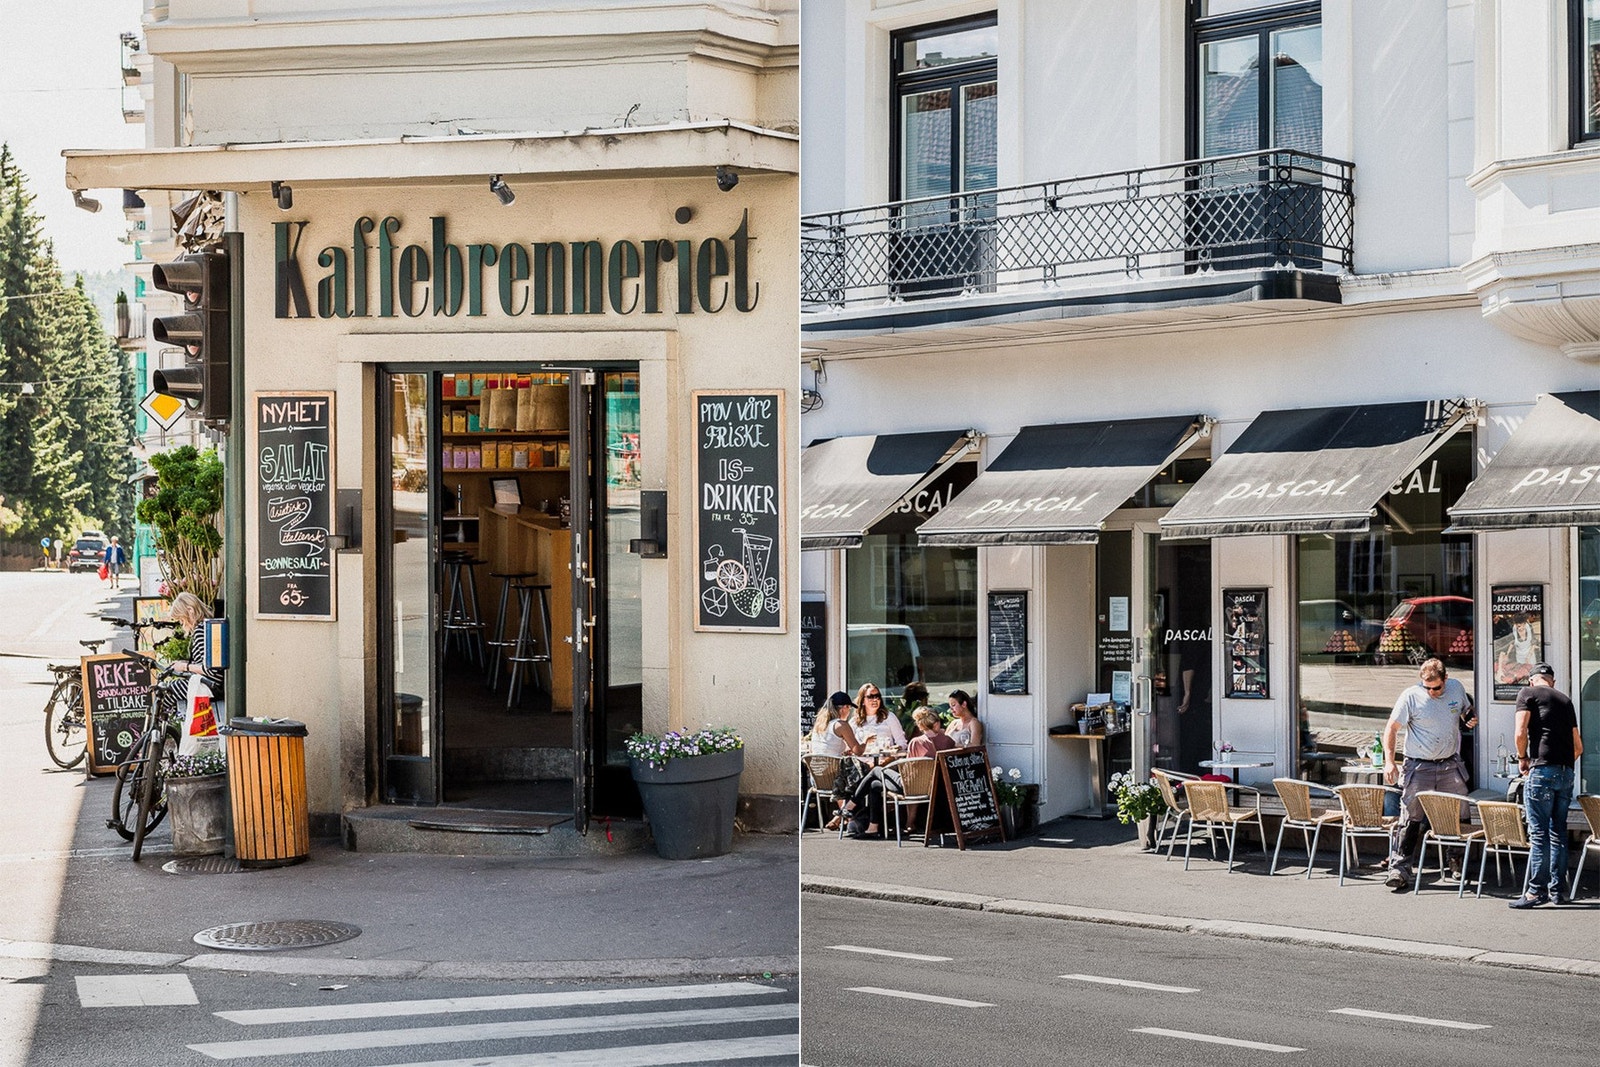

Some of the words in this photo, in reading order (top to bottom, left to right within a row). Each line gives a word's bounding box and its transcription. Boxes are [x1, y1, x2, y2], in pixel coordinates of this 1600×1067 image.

[271, 207, 759, 319] Kaffebrenneriet
[262, 401, 326, 423] NYHET
[260, 441, 328, 483] SALAT
[719, 458, 754, 481] IS-
[1214, 474, 1361, 506] PASCAL
[1509, 465, 1600, 493] PAS
[703, 482, 777, 515] DRIKKER
[801, 499, 869, 519] SCAL
[893, 483, 953, 514] SCAL
[966, 491, 1099, 519] PASCAL
[265, 556, 322, 571] BØNNESALAT
[1493, 603, 1542, 612] DESSERTKURS
[1164, 626, 1212, 645] PASCAL
[94, 662, 144, 689] REKE-
[97, 685, 148, 699] SANDWICHEN
[105, 694, 149, 710] TILBAKE
